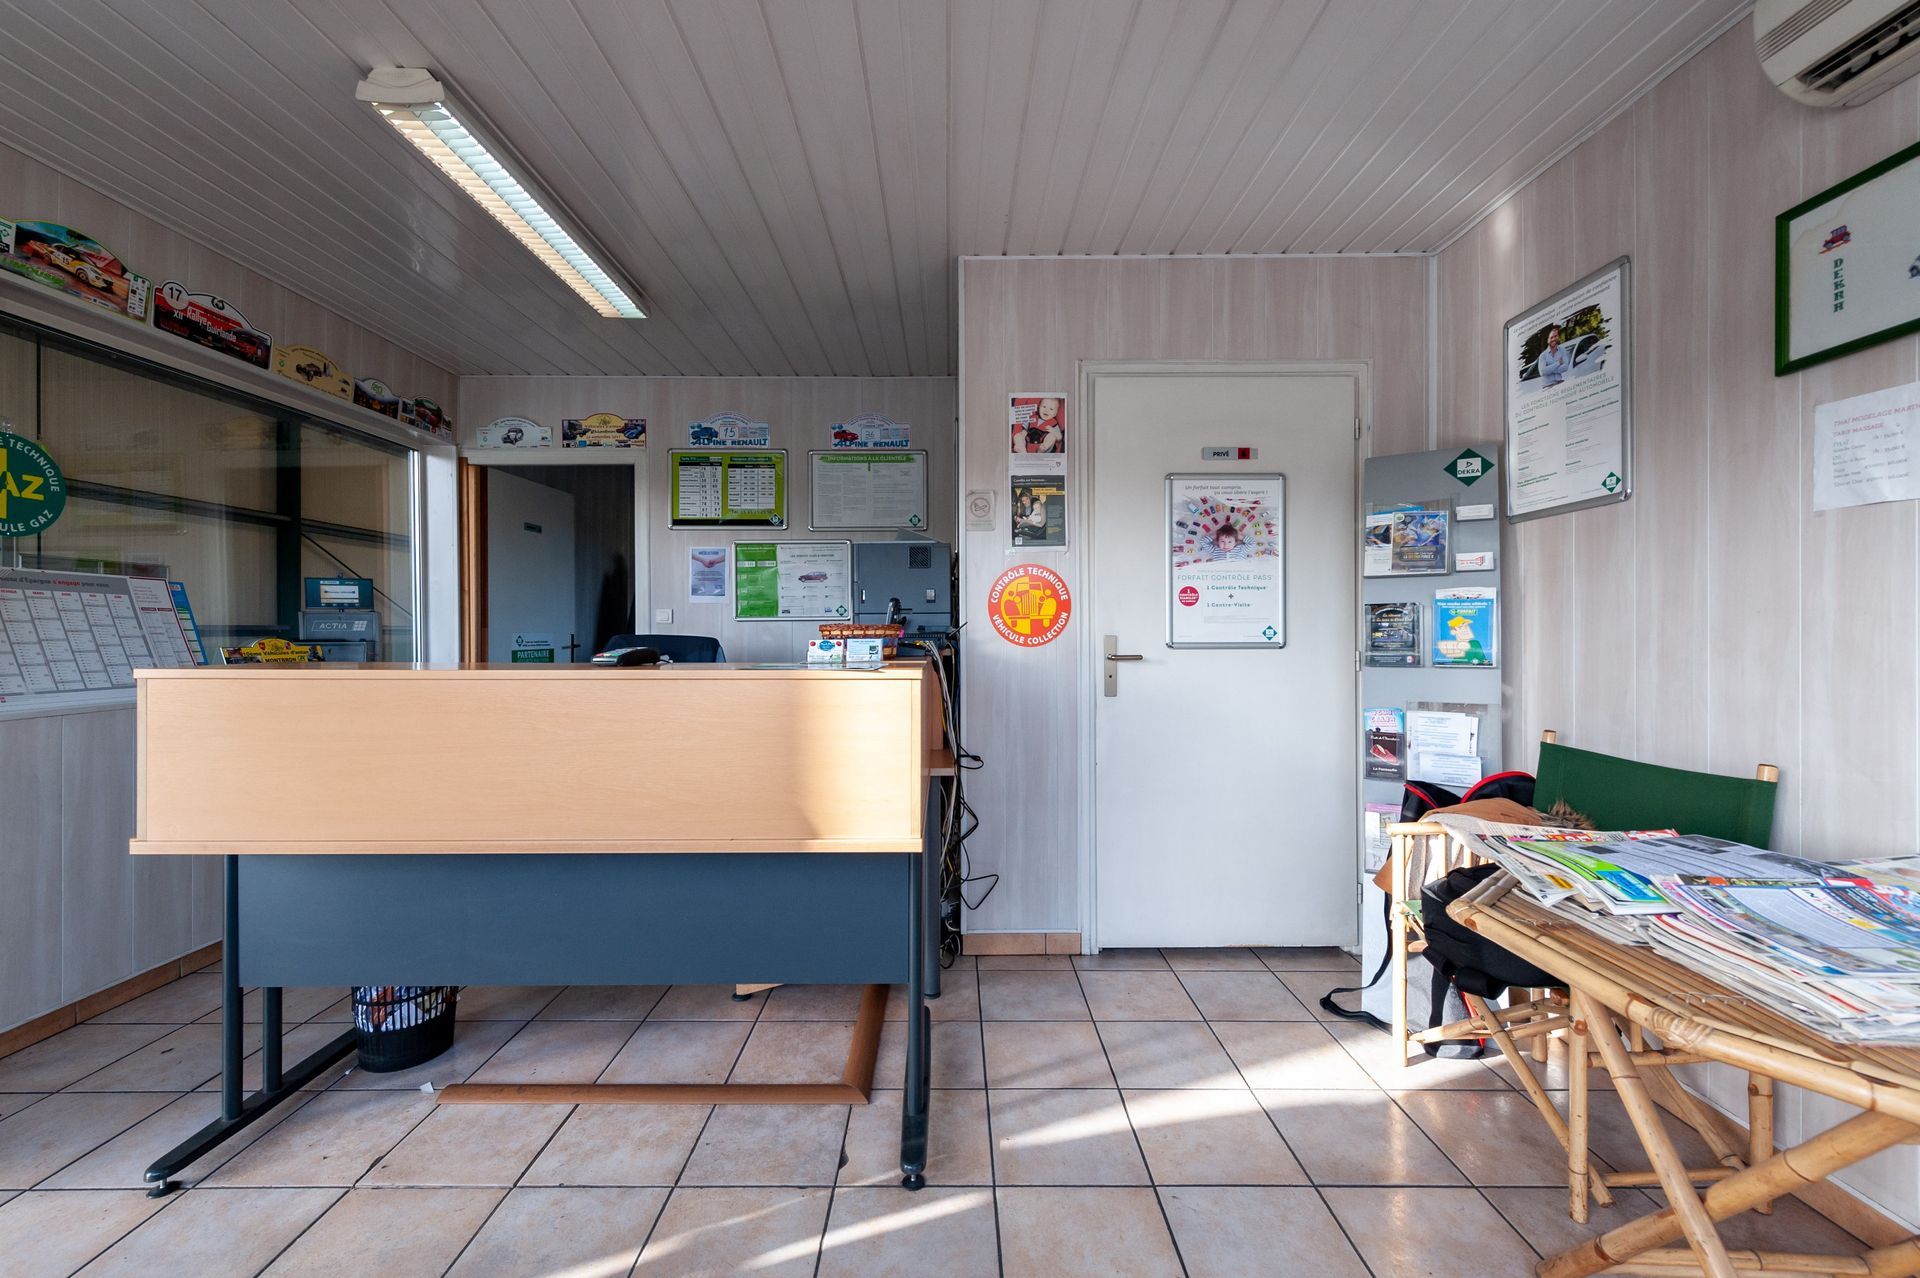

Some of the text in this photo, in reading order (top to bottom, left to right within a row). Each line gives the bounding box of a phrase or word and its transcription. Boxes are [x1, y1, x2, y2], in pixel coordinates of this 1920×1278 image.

[169, 287, 181, 301] 17
[1833, 258, 1845, 312] DEKRA
[187, 306, 208, 326] Rallye
[206, 322, 237, 343] Guirlande
[1579, 376, 1614, 392] AUTOMOBILE
[724, 428, 736, 438] 15
[9, 438, 60, 492] TECHNIQUE
[0, 472, 44, 501] AZ
[30, 509, 53, 533] GAZ
[991, 567, 1069, 603] CONTRÔLE TECHNIQUE
[992, 612, 1069, 645] VÉHICULE COLLECTION
[517, 650, 550, 658] PARTENAIRE
